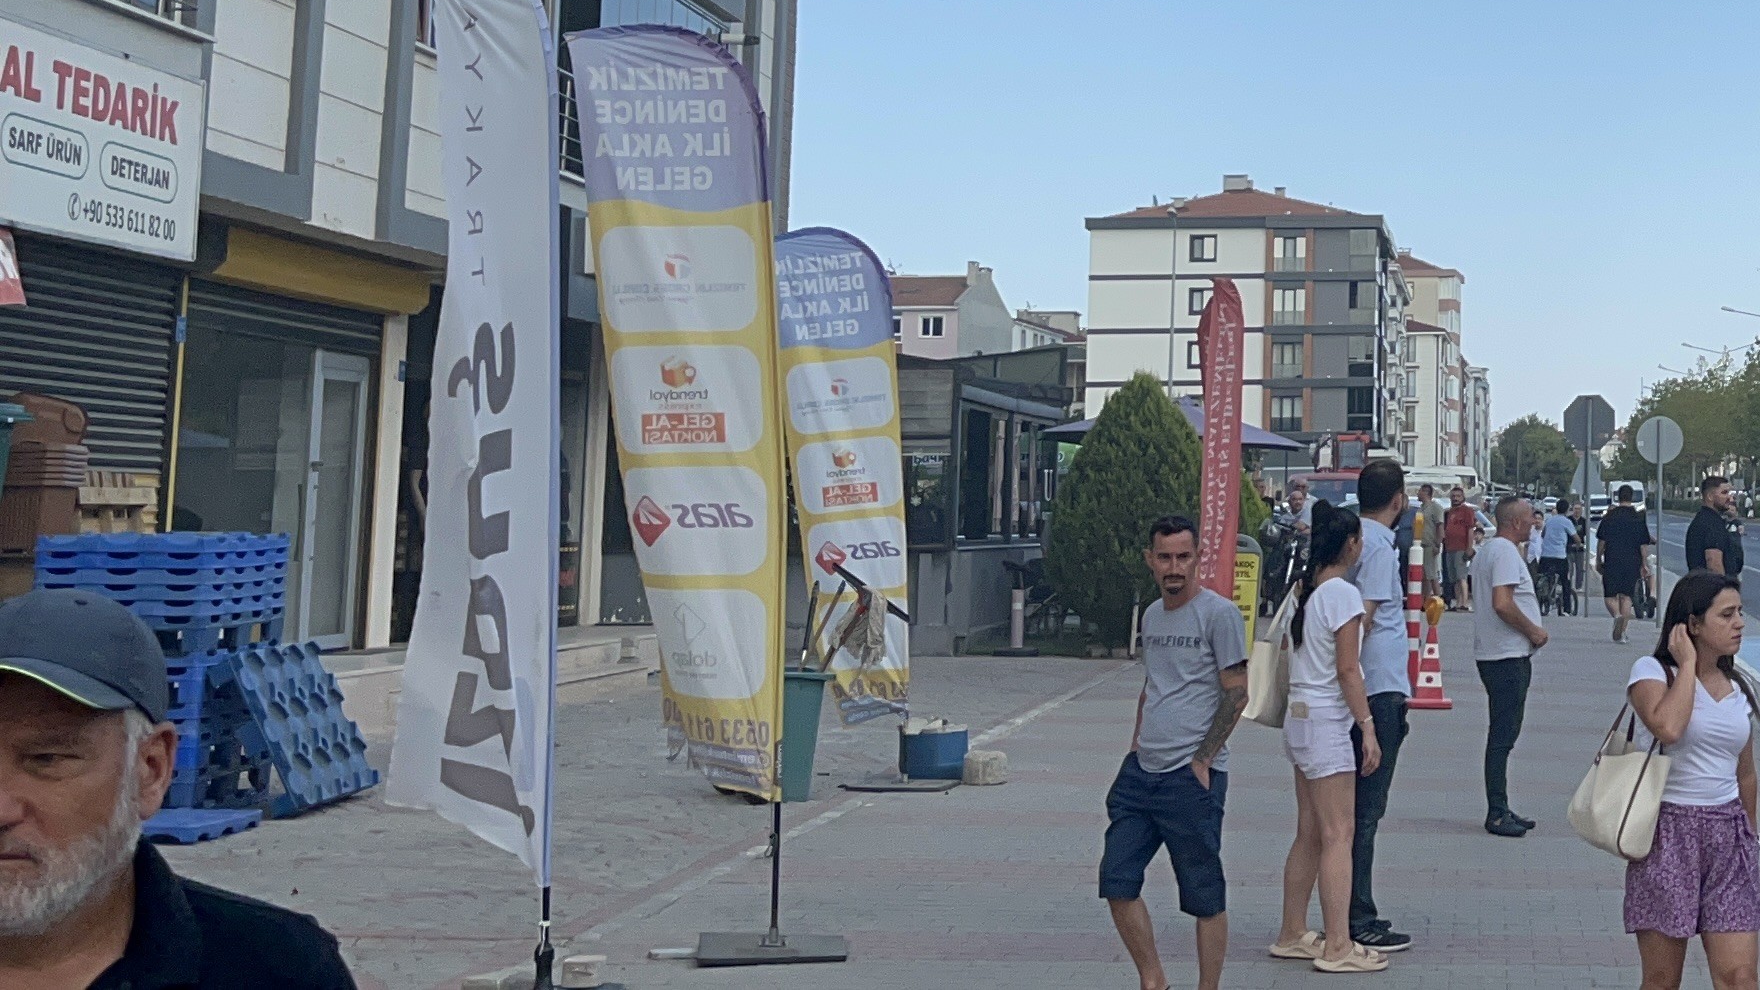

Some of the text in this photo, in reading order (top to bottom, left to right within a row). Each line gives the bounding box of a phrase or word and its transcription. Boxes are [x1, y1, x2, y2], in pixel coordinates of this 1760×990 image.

[53, 60, 180, 146] TEDARİK
[8, 126, 82, 166] SARF ÜRÜN
[110, 155, 170, 190] DETERJAN
[83, 200, 176, 241] +90 533 611 82 00
